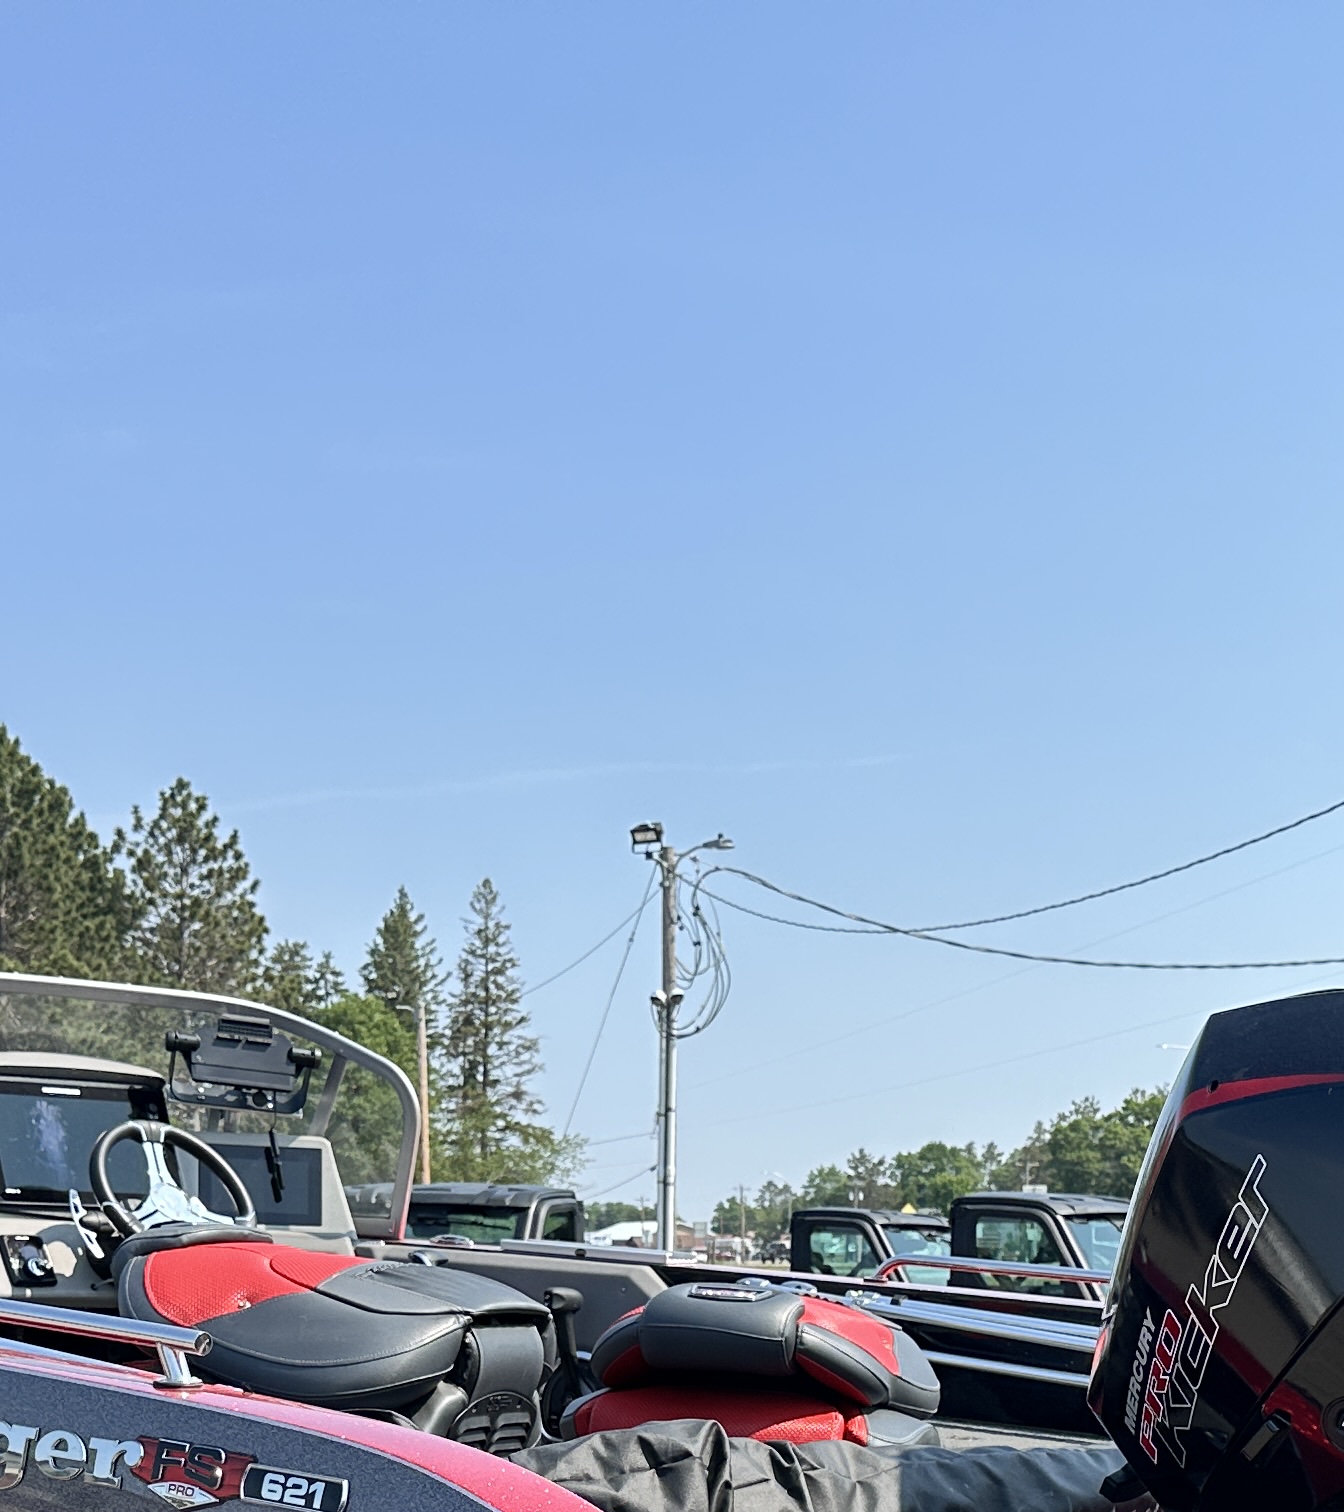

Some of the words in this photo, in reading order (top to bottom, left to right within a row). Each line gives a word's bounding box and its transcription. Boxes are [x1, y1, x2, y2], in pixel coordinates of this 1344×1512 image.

[1124, 1306, 1156, 1436] MERCURY
[1139, 1308, 1182, 1465] PRO
[151, 1438, 226, 1491] FS
[261, 1472, 326, 1510] 621
[167, 1483, 195, 1497] PRO
